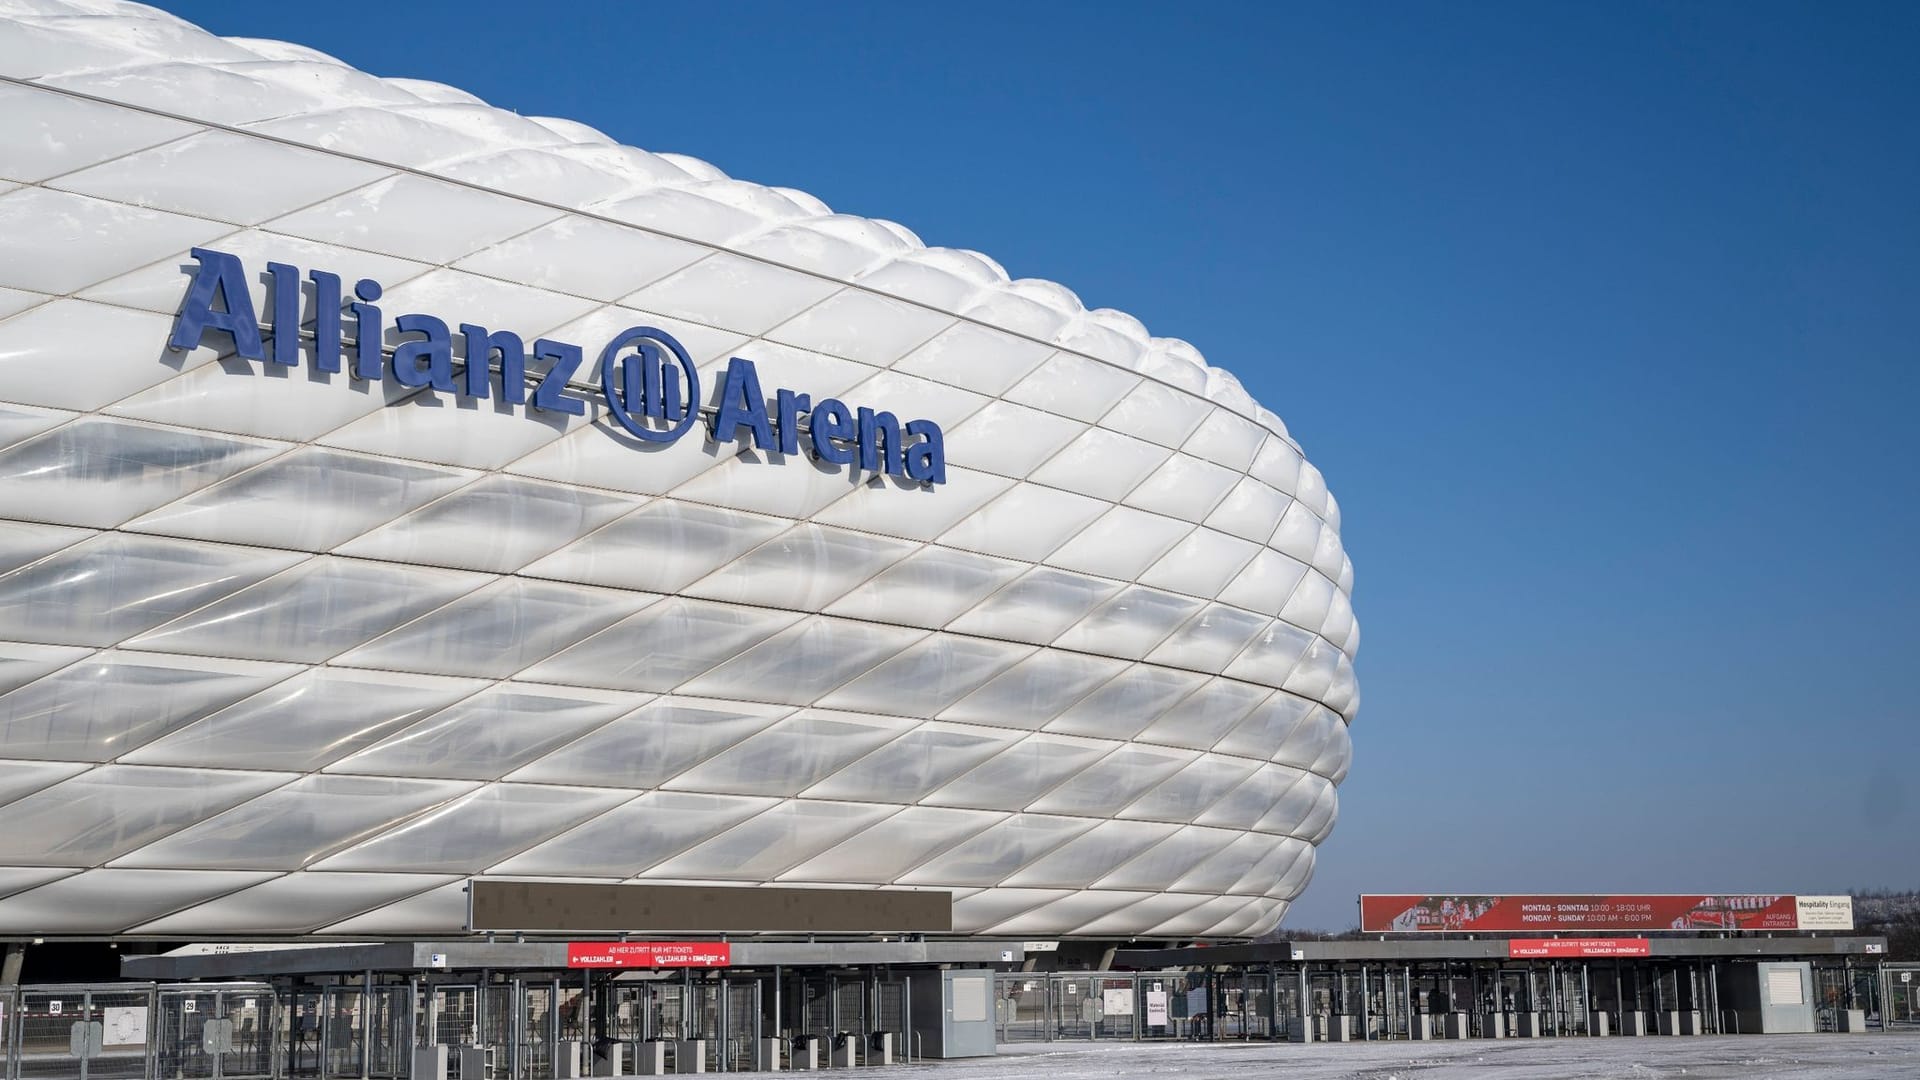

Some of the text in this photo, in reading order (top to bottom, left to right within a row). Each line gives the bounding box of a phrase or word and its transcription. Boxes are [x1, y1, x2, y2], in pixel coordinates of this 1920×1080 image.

[170, 246, 947, 486] Allianz Arena
[1522, 904, 1551, 912] MONTAG
[1557, 904, 1589, 912] SONNTAG
[1636, 904, 1651, 912] UHR
[1799, 900, 1850, 910] Hospitality Eingang
[1522, 914, 1551, 922] MONDAY
[1558, 914, 1585, 922] SUNDAY
[1607, 914, 1618, 922] AM
[1641, 914, 1652, 922] PM
[608, 946, 617, 954] AB
[50, 1003, 60, 1012] 30
[186, 1002, 194, 1011] 29
